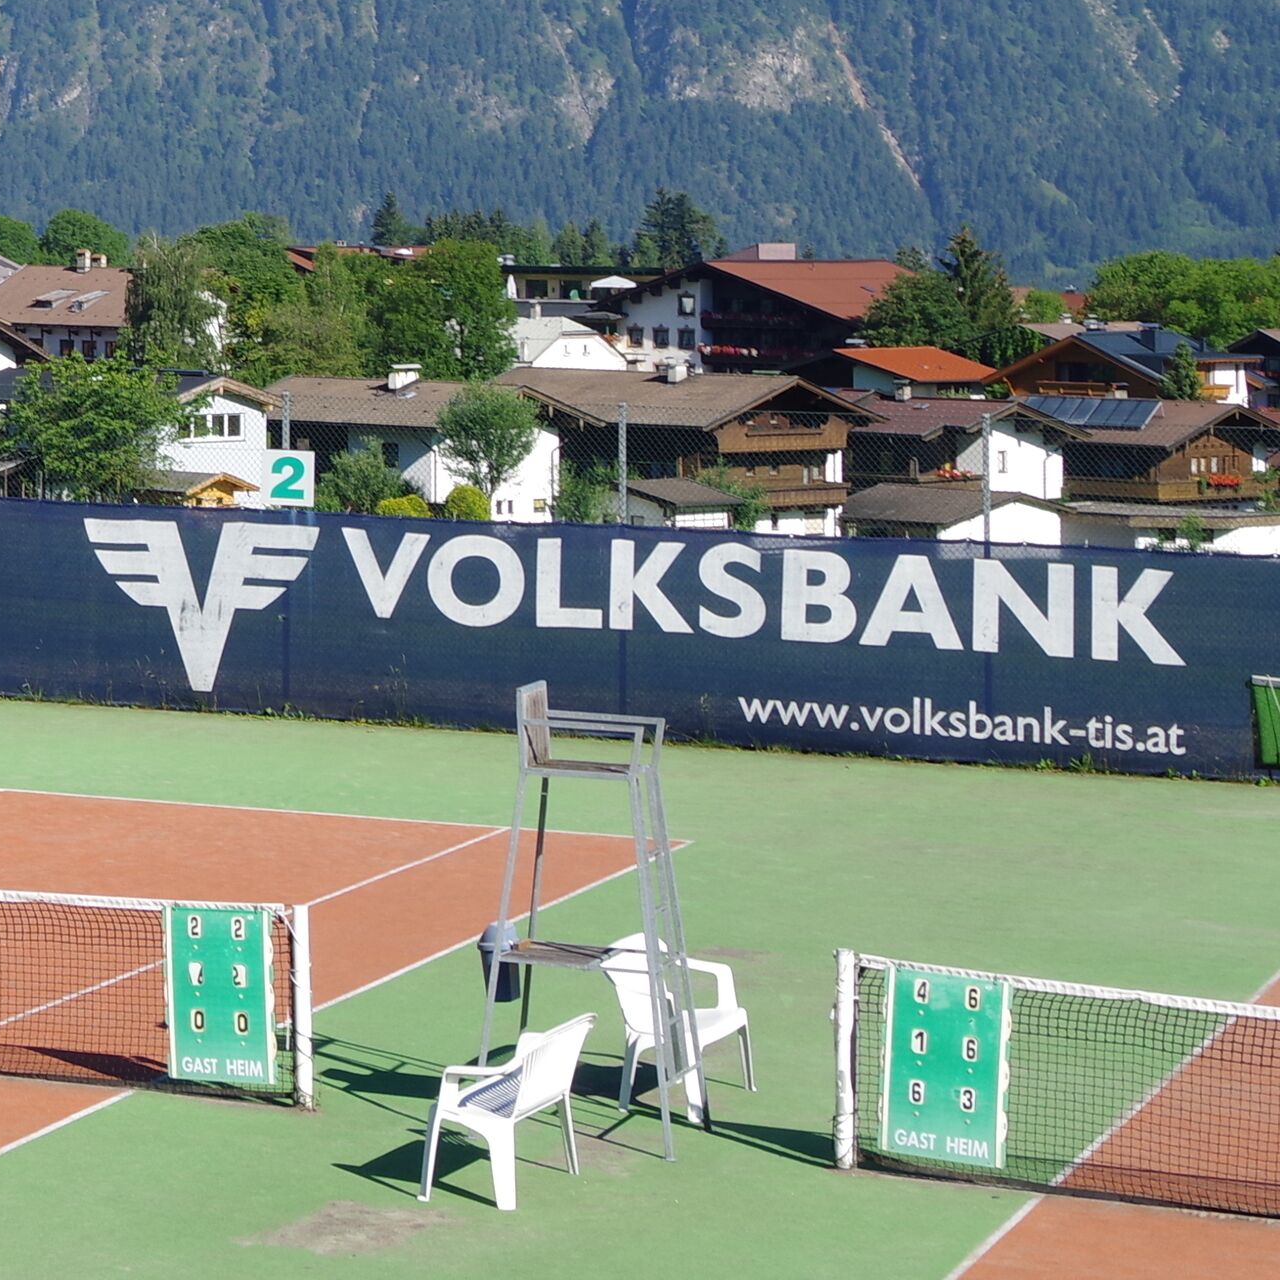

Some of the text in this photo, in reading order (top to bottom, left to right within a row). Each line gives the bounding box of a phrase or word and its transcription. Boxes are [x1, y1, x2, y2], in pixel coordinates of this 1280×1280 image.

[270, 456, 306, 500] 2
[341, 526, 1188, 667] VOLKSBANK
[738, 695, 1188, 757] www.volksbank-tis.at
[190, 916, 243, 938] 2 2
[917, 981, 978, 1008] 4 6
[194, 1010, 248, 1033] 0 0
[914, 1031, 976, 1059] 1 6
[182, 1056, 264, 1078] GAST HEIM
[911, 1083, 973, 1110] 6 3
[894, 1129, 990, 1158] GAST HEIM
